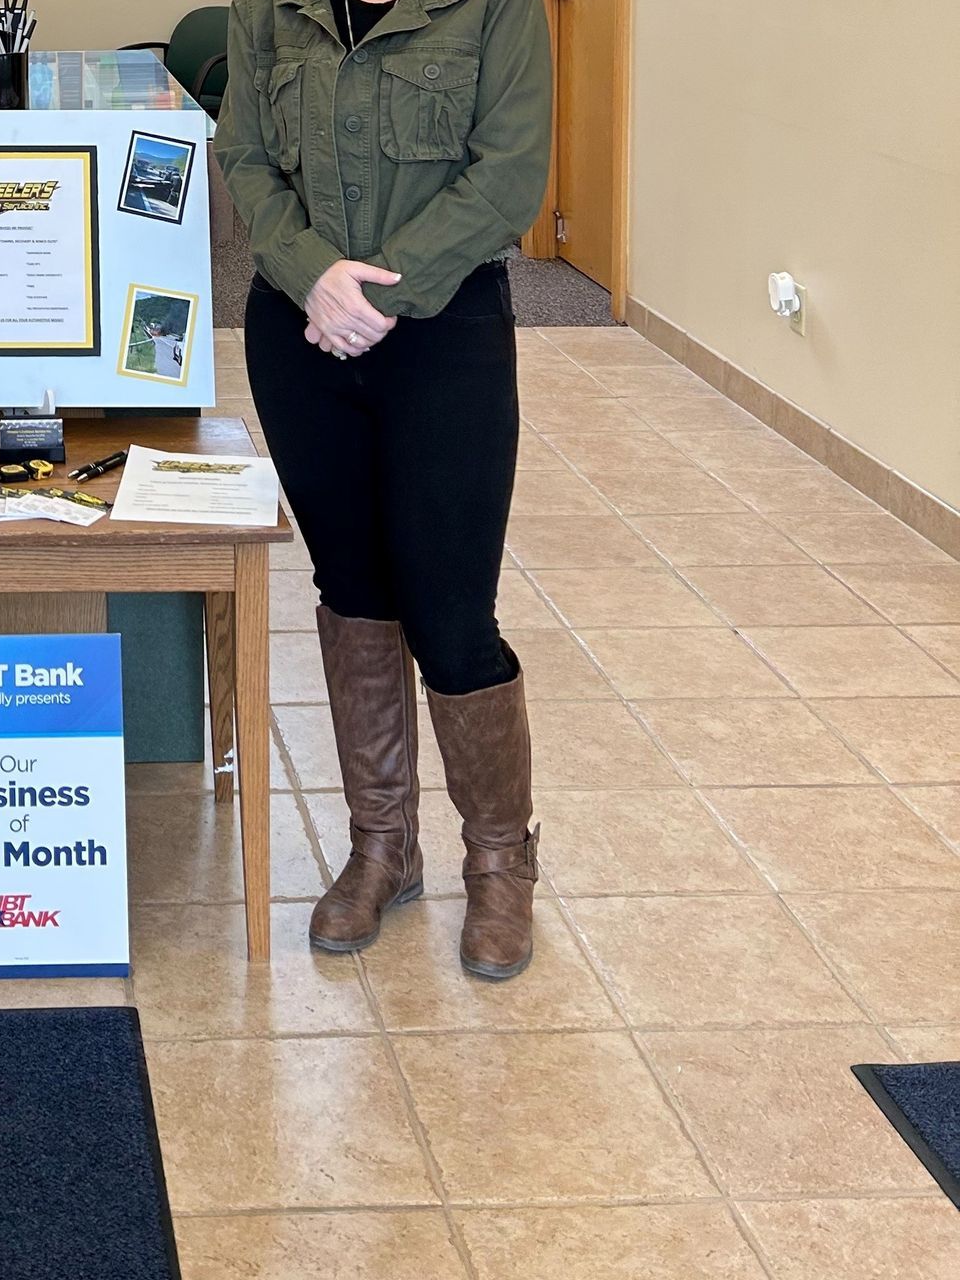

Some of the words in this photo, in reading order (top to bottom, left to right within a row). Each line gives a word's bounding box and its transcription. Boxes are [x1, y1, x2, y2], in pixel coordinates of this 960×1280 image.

[15, 662, 84, 687] Bank
[15, 691, 71, 706] presents
[0, 755, 37, 773] Our
[9, 814, 29, 833] of
[3, 839, 107, 867] Month
[0, 910, 61, 928] BANK
